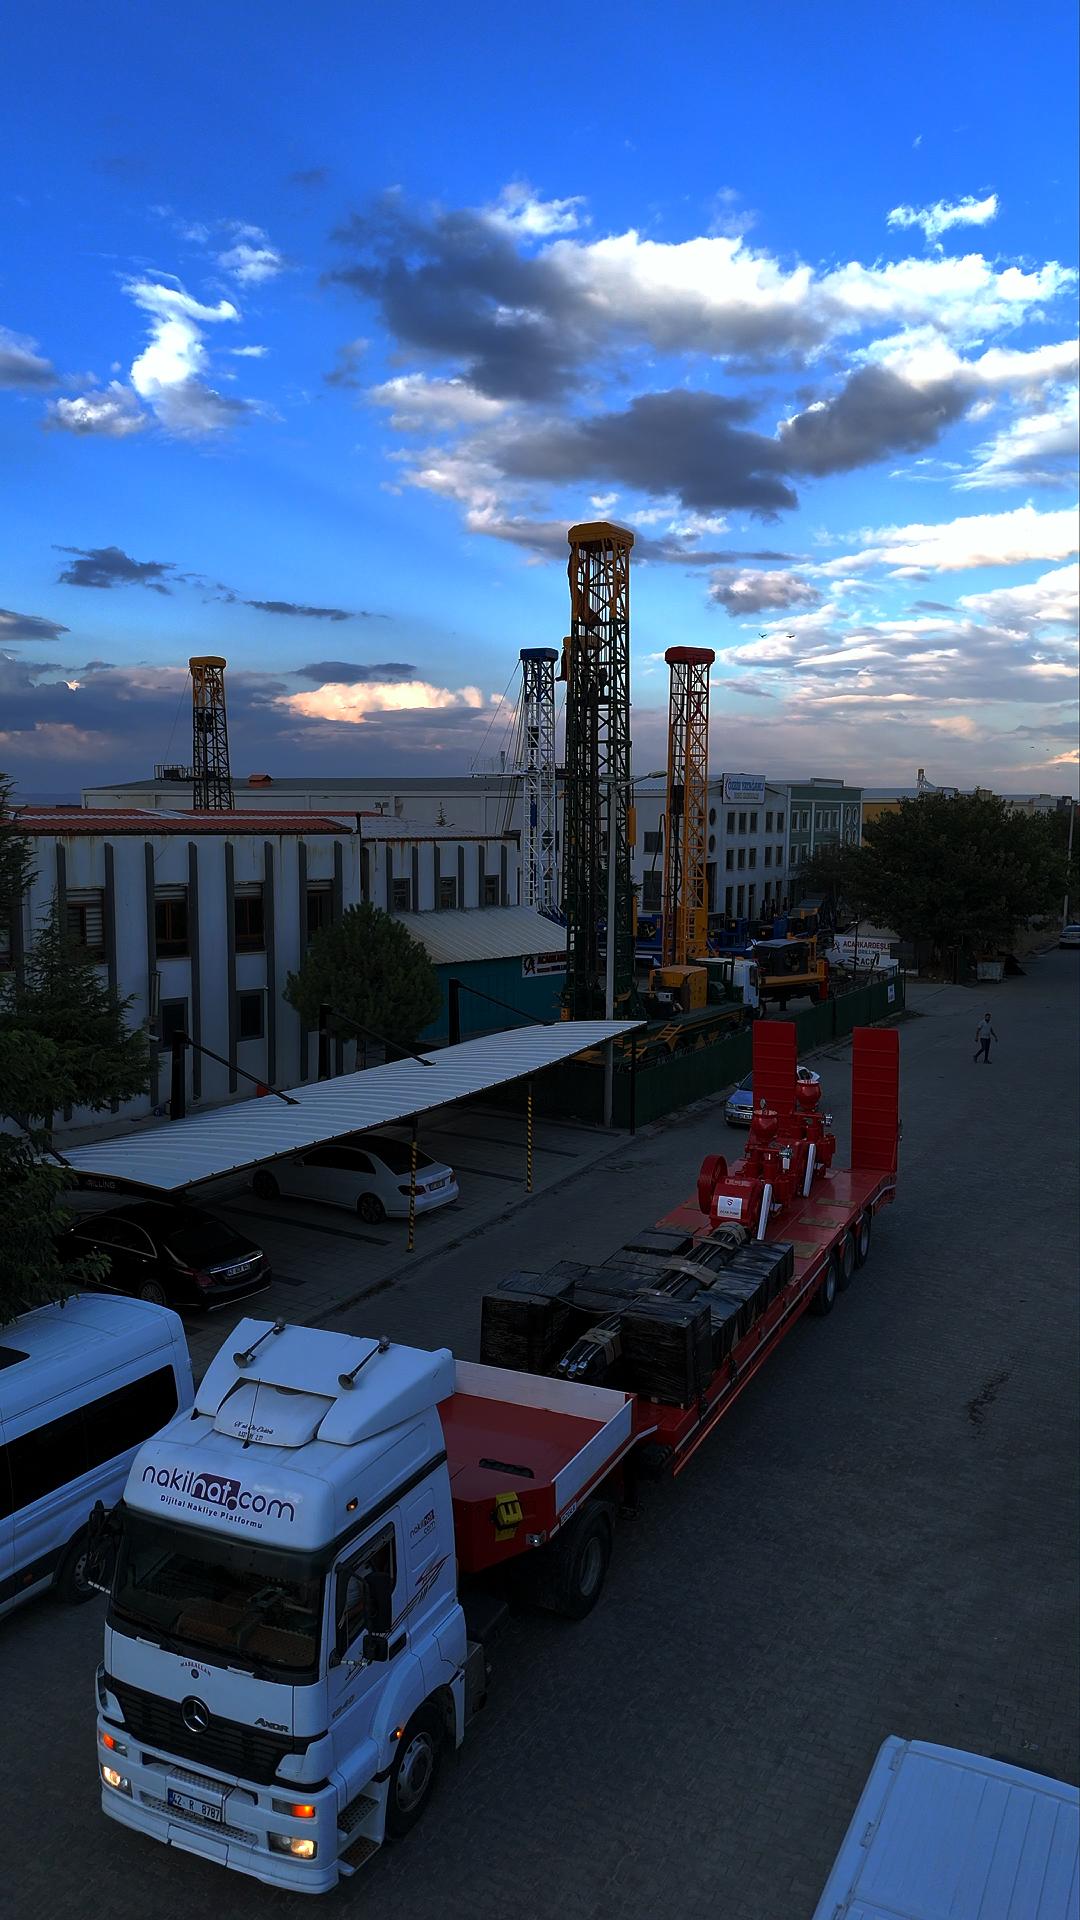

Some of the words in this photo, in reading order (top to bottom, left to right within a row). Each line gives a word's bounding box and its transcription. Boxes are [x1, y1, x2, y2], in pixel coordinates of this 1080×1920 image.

[843, 940, 892, 950] ACARKARDEŞLE
[142, 1465, 295, 1522] nakilnat.com
[160, 1494, 186, 1508] Dijital
[187, 1501, 219, 1517] Nakliye
[220, 1510, 263, 1529] Platformu
[189, 1799, 195, 1811] R
[201, 1804, 221, 1820] 8787
